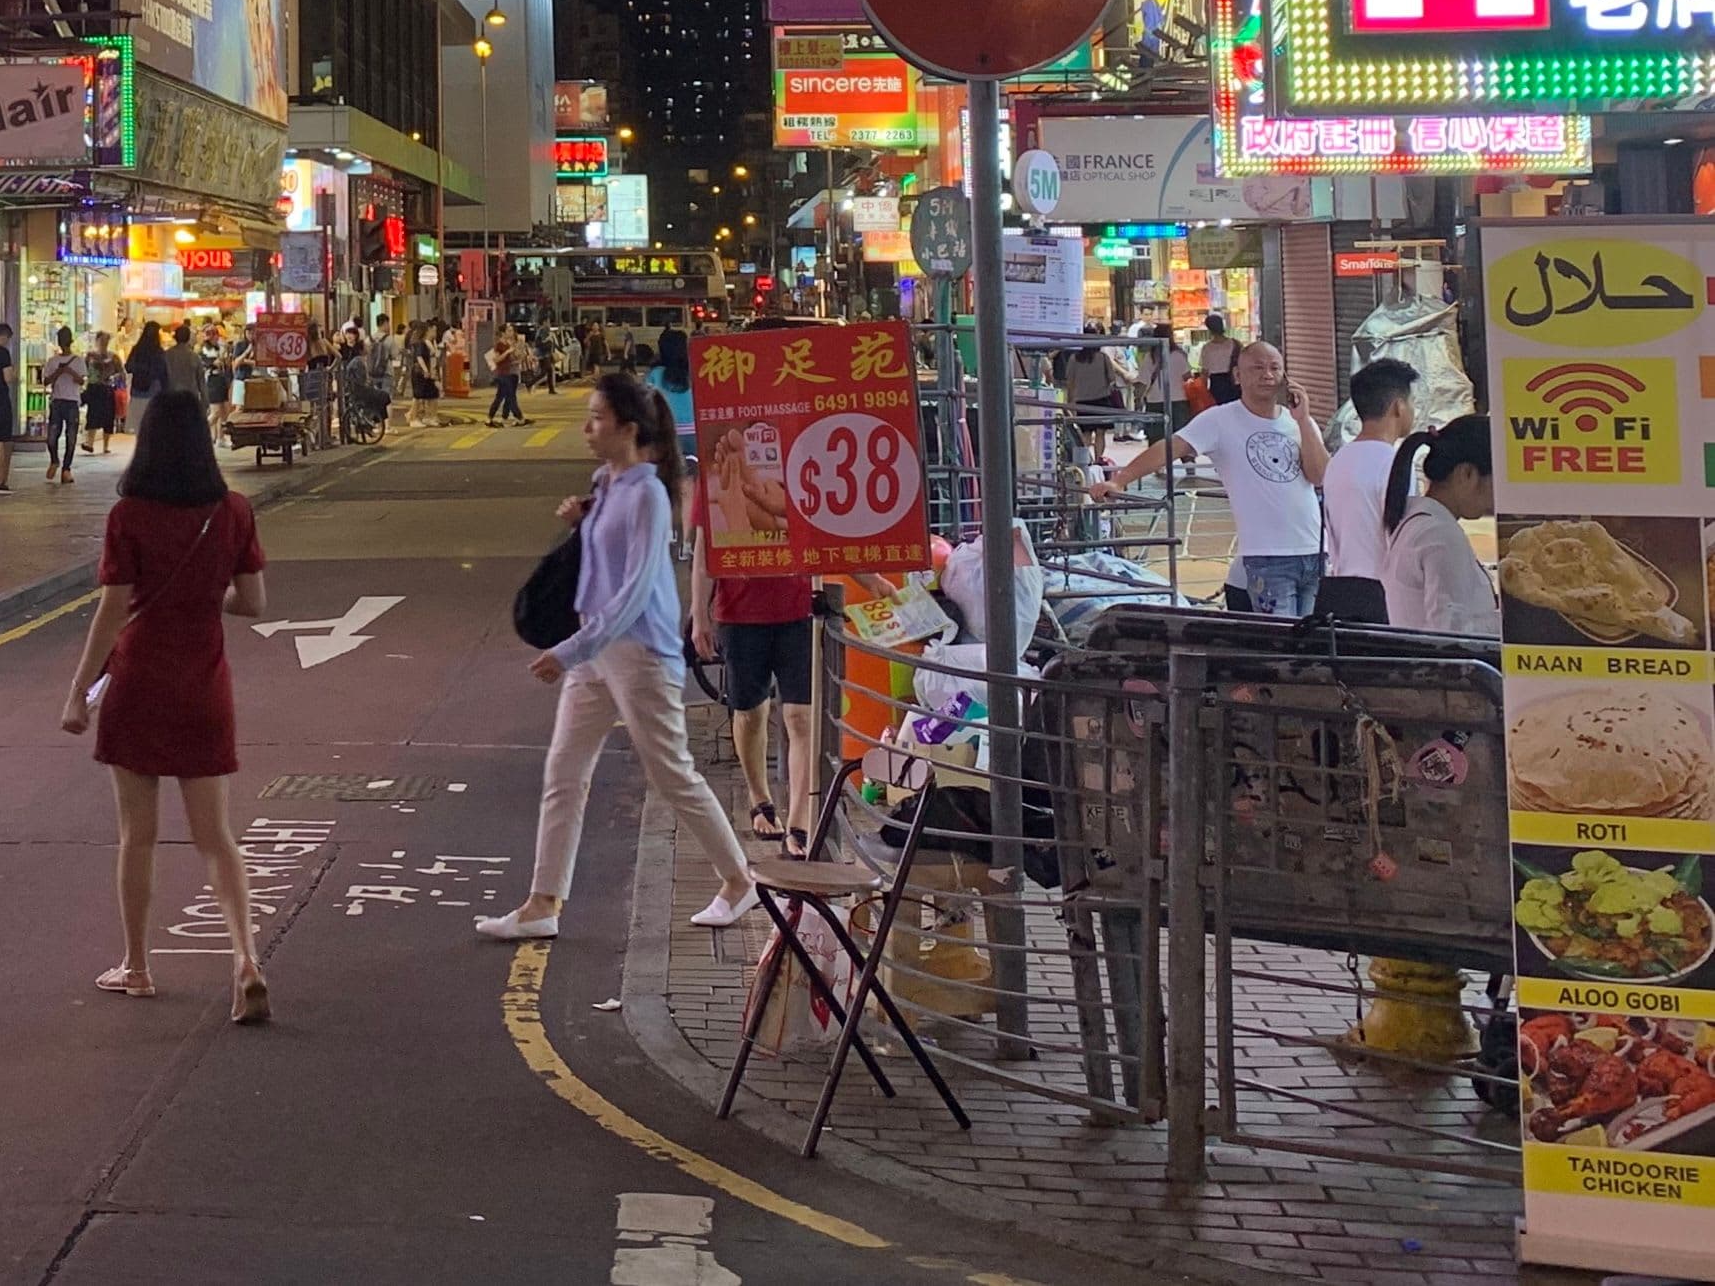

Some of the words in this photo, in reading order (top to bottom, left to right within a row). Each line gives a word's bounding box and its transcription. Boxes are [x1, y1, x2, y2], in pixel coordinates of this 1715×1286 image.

[790, 76, 872, 93] sincere
[851, 130, 877, 141] 2377
[885, 129, 913, 140] 2263
[1241, 115, 1396, 156] 政府註冊
[1408, 115, 1567, 155] 信心保證
[1083, 171, 1126, 182] OPTICAL
[1128, 170, 1157, 181] SHOP
[1084, 154, 1155, 170] FRANCE
[1030, 169, 1058, 201] 5M
[1505, 251, 1694, 327] حلال
[698, 331, 911, 395] 御足苑
[738, 404, 763, 418] FOOT
[763, 402, 811, 416] MASSAGE
[814, 394, 858, 411] 6491
[865, 390, 910, 408] 9894
[799, 424, 900, 520] $38
[1522, 446, 1648, 474] FREE
[1517, 654, 1583, 673] NAAN
[1607, 657, 1692, 677] BREAD
[1576, 821, 1627, 843] ROTI
[1558, 985, 1620, 1008] ALOO
[1624, 991, 1681, 1013] GOBI
[1567, 1155, 1701, 1184] TANDOORIE
[1582, 1175, 1683, 1200] CHICKEN
